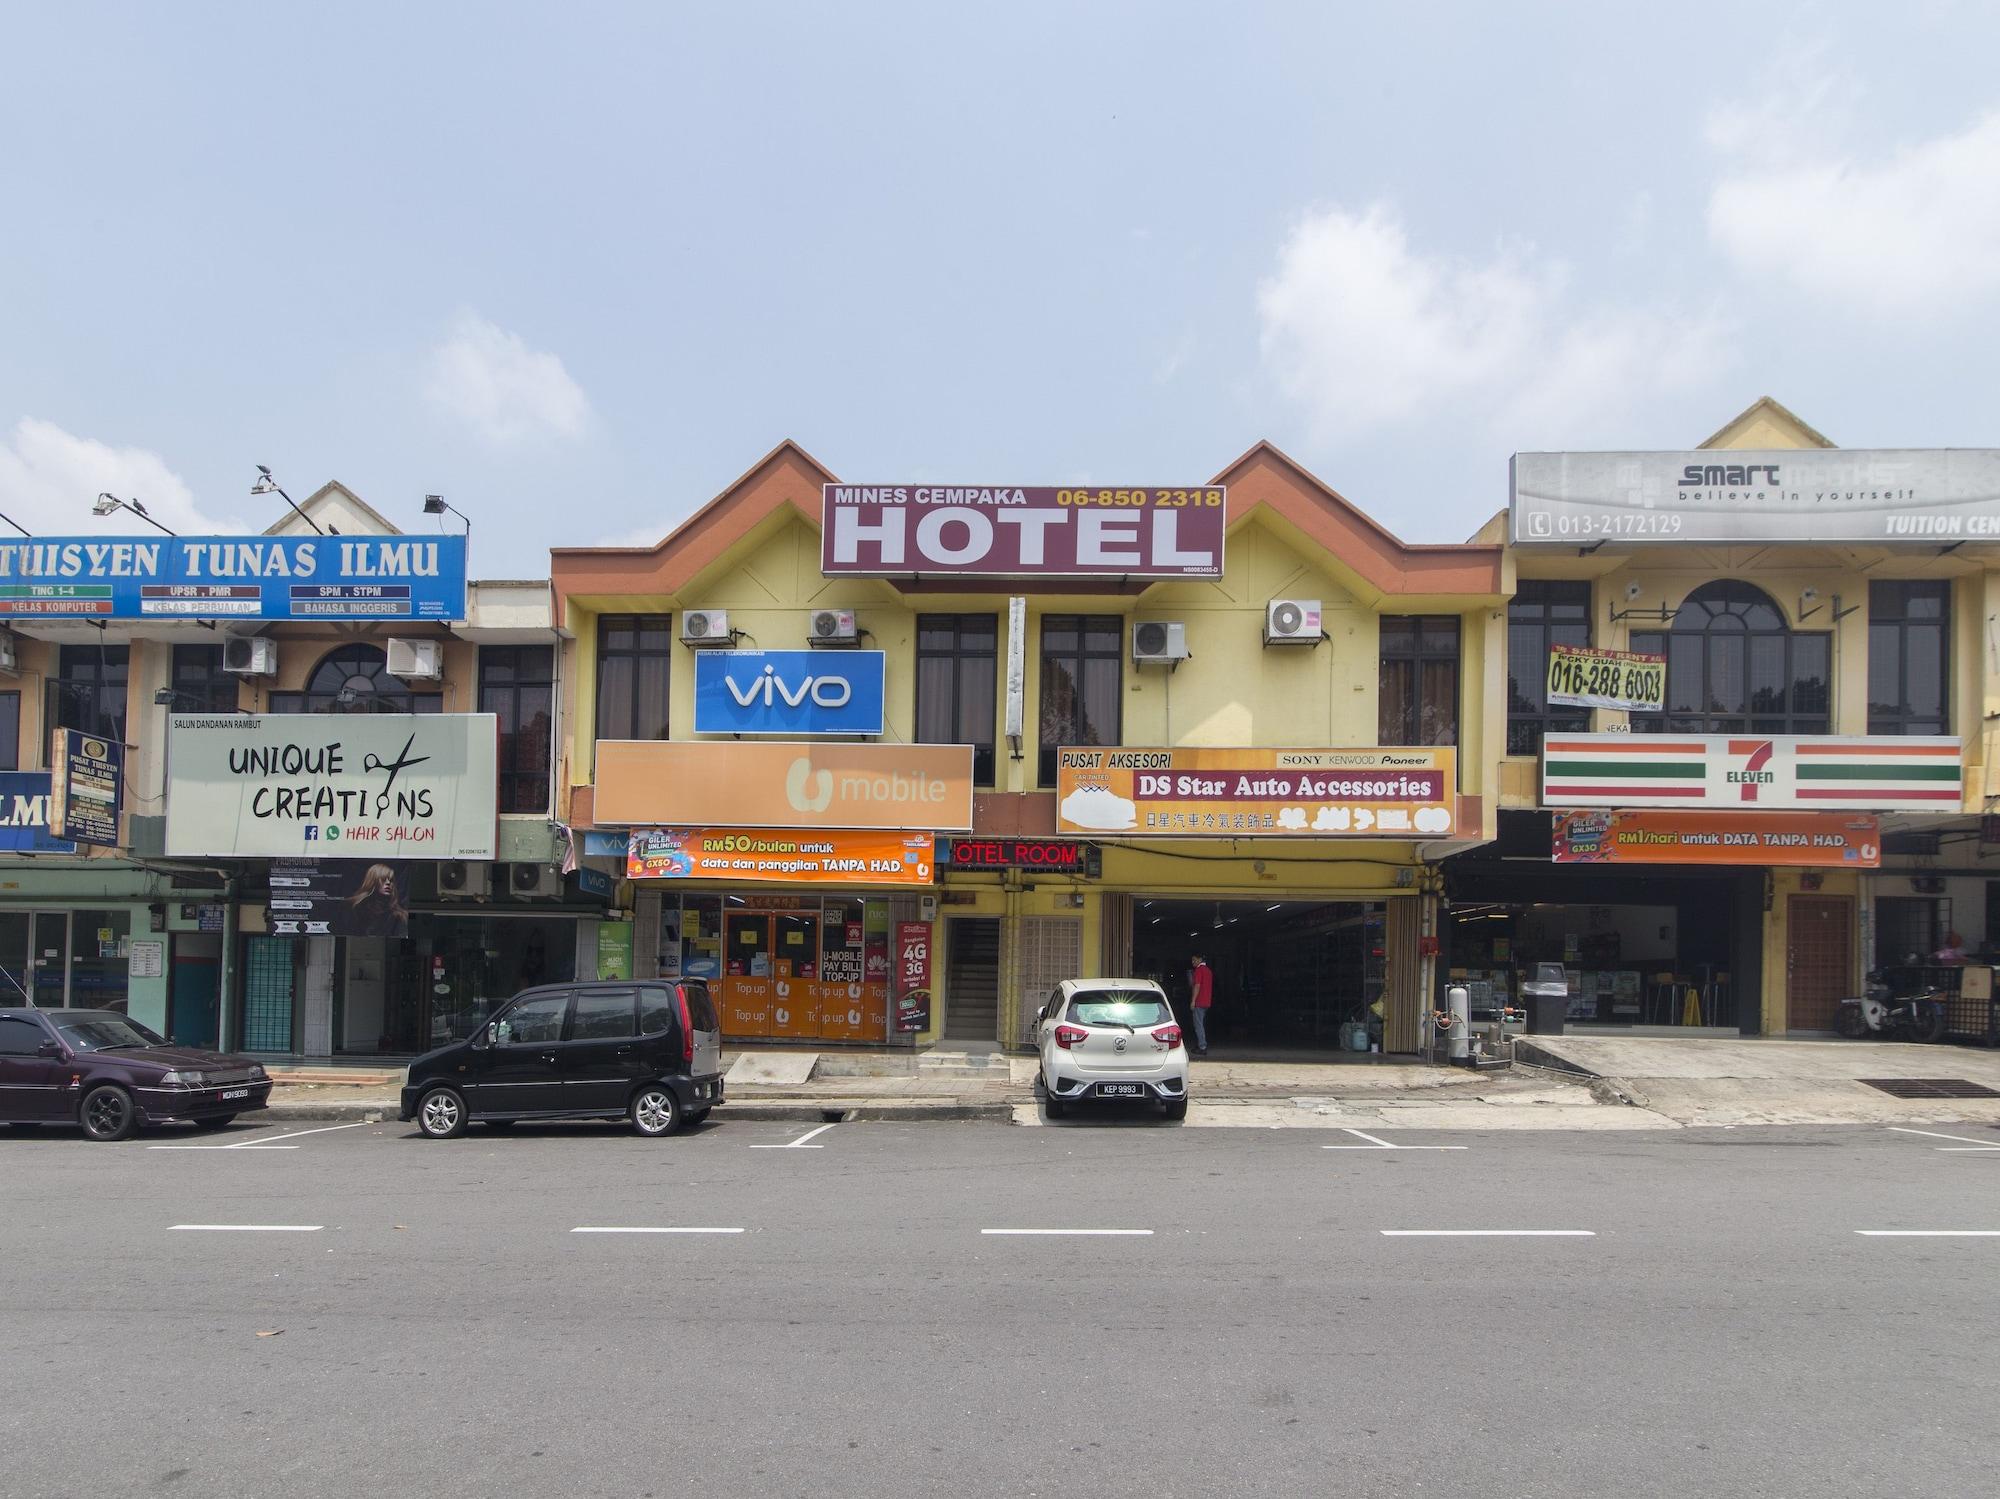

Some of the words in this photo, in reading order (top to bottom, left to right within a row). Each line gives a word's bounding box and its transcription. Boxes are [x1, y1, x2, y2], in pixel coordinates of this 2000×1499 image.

[1678, 465, 1780, 487] smart
[835, 488, 908, 504] MINES
[914, 488, 1027, 505] CEMPAKA
[1056, 490, 1147, 506] 06-850
[1155, 491, 1221, 507] 2318
[1679, 489, 1766, 501] believe
[1781, 489, 1799, 500] in
[1816, 489, 1914, 502] yourself
[1558, 515, 1682, 534] 013-2172129
[1886, 515, 1962, 534] TUITION
[833, 506, 1213, 567] HOTEL
[183, 543, 317, 577] TUNAS
[340, 543, 440, 577] ILMU
[31, 586, 54, 596] TING
[170, 586, 197, 596] UPSR
[208, 586, 231, 596] PMR
[319, 586, 342, 597] SPM
[353, 586, 382, 597] STPM
[12, 602, 42, 612] KELAS
[46, 602, 97, 612] KOMPUTER
[304, 603, 345, 613] BAHASA
[349, 603, 397, 613] INGGERIS
[1572, 647, 1606, 657] SALE
[1616, 652, 1649, 662] RENT
[725, 664, 851, 707] vivo
[1551, 660, 1621, 699] 016-288
[1625, 668, 1661, 702] 6003
[174, 719, 195, 729] SALUN
[196, 719, 233, 729] DANDANAN
[234, 719, 262, 729] RAMBUT
[229, 742, 344, 777] UNIQUE
[1061, 753, 1102, 768] PUSAT
[1107, 753, 1172, 769] AKSESORI
[1283, 755, 1323, 765] SONY
[1328, 755, 1375, 765] KENWOOD
[1728, 740, 1773, 801] 7
[840, 770, 946, 803] mobile
[1139, 776, 1171, 796] DS
[1177, 775, 1226, 796] Star
[1233, 775, 1291, 796] Auto
[346, 826, 380, 841] HAIR
[386, 826, 434, 841] SALON
[1572, 825, 1608, 834] UNLIMITED
[703, 835, 796, 853] RM50/bulan
[800, 843, 834, 853] untuk
[1618, 830, 1678, 844] RM1/hari
[1681, 834, 1719, 845] untuk
[1723, 833, 1759, 845] DATA
[1763, 834, 1809, 846] TANPA
[1813, 834, 1849, 846] HAD.
[647, 842, 682, 850] UNLIMITED
[1015, 843, 1078, 864] ROOM
[701, 858, 729, 869] data
[732, 859, 755, 869] dan
[758, 859, 819, 873] panggilan
[822, 859, 866, 872] TANPA
[870, 859, 904, 872] HAD.
[823, 951, 862, 961] U-MOBILE
[903, 943, 927, 960] 4G
[823, 961, 840, 972] PAY
[842, 961, 860, 972] BILL
[906, 961, 923, 976] 3G
[825, 972, 859, 982] TOP-UP
[736, 982, 752, 995] Top
[754, 984, 766, 995] up
[735, 1009, 751, 1022] Top
[753, 1011, 765, 1021] up
[1104, 1085, 1117, 1094] KEP
[1118, 1085, 1137, 1094] 9993
